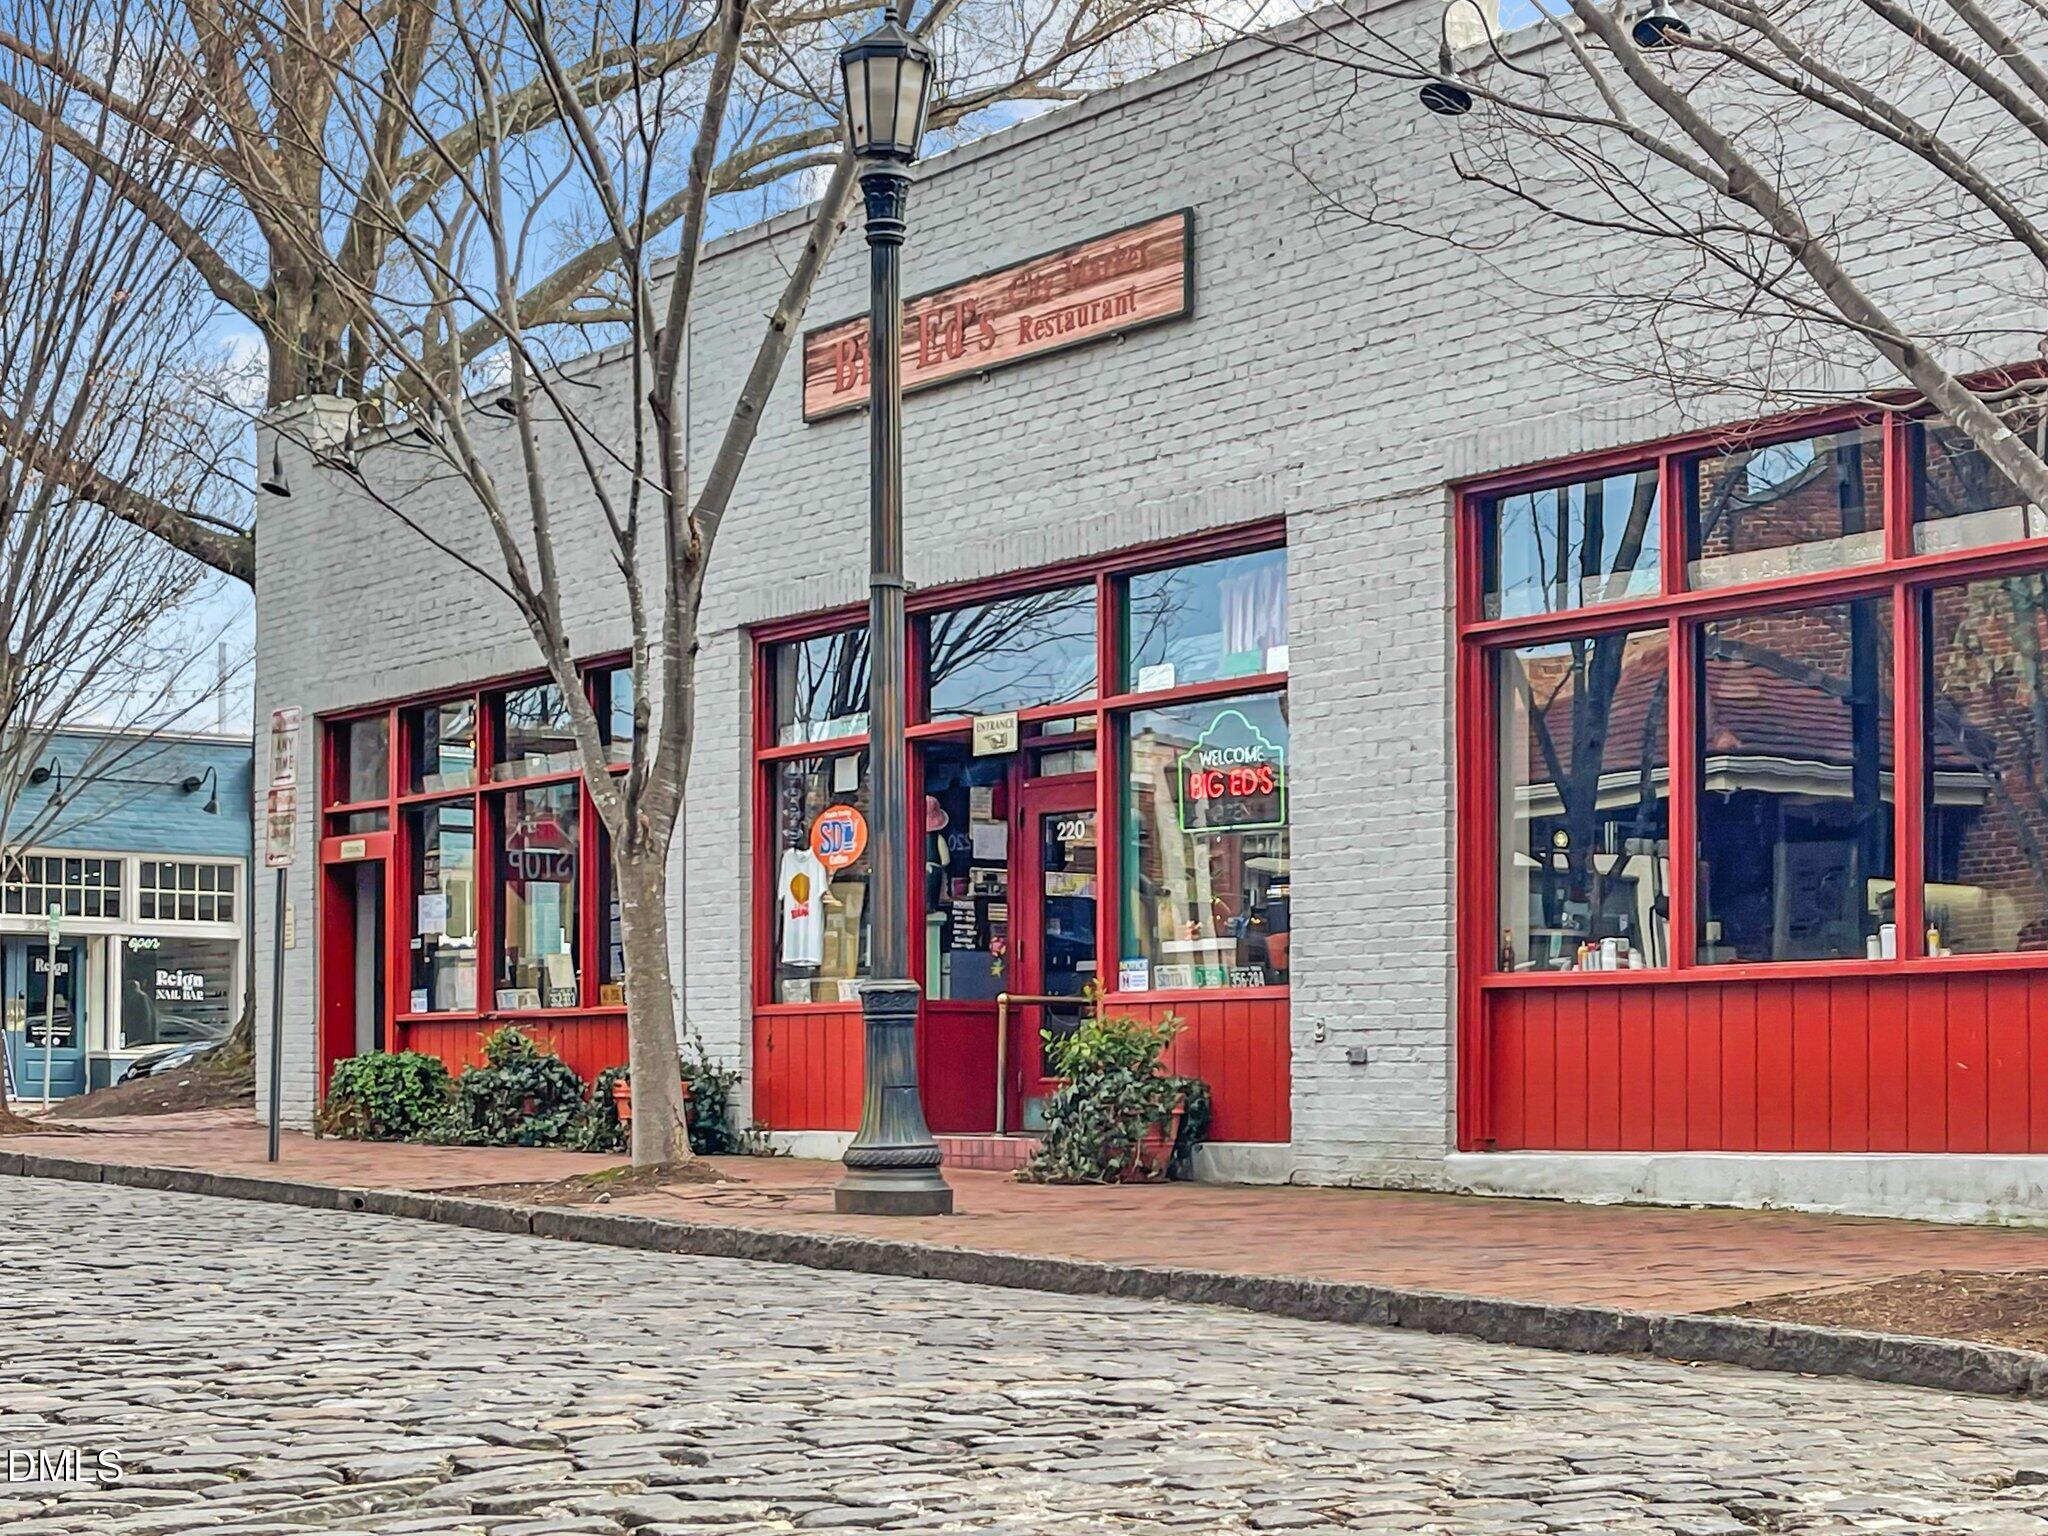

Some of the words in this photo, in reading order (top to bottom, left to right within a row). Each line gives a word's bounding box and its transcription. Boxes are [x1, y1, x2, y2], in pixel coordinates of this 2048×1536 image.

[1018, 284, 1137, 345] Restaurant
[833, 331, 870, 394] Bi
[917, 298, 996, 370] Ed's
[976, 717, 1015, 733] ENTRANCE
[1199, 745, 1265, 767] WELCOME
[1190, 770, 1226, 800] BIG
[1228, 764, 1275, 796] ED'S
[1056, 820, 1085, 841] 220
[35, 957, 69, 976] Regn
[155, 969, 204, 991] Reign
[155, 989, 181, 1000] NAIL
[183, 989, 204, 1001] BAR
